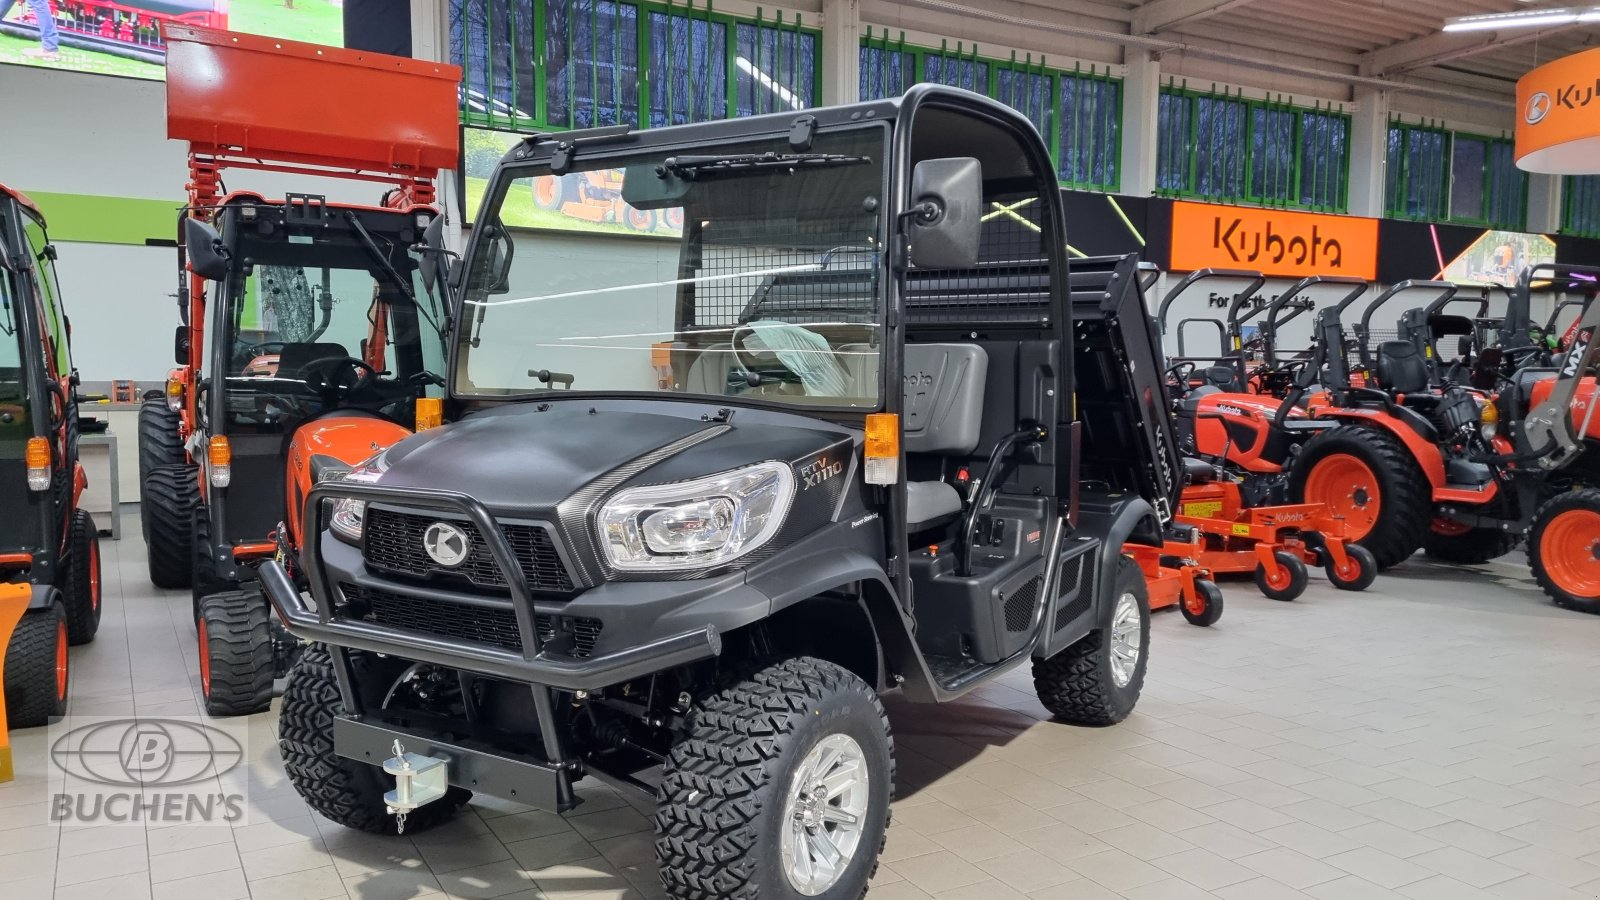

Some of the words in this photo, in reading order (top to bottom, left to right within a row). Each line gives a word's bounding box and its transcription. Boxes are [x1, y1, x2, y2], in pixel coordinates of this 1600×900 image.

[1213, 216, 1342, 268] Kubota
[1209, 292, 1229, 308] For
[1564, 341, 1587, 377] MX
[1219, 404, 1241, 415] Kubota
[801, 457, 827, 477] RTV
[1156, 425, 1172, 493] Kubota
[803, 461, 843, 491] X1110
[1275, 512, 1304, 522] Kubota
